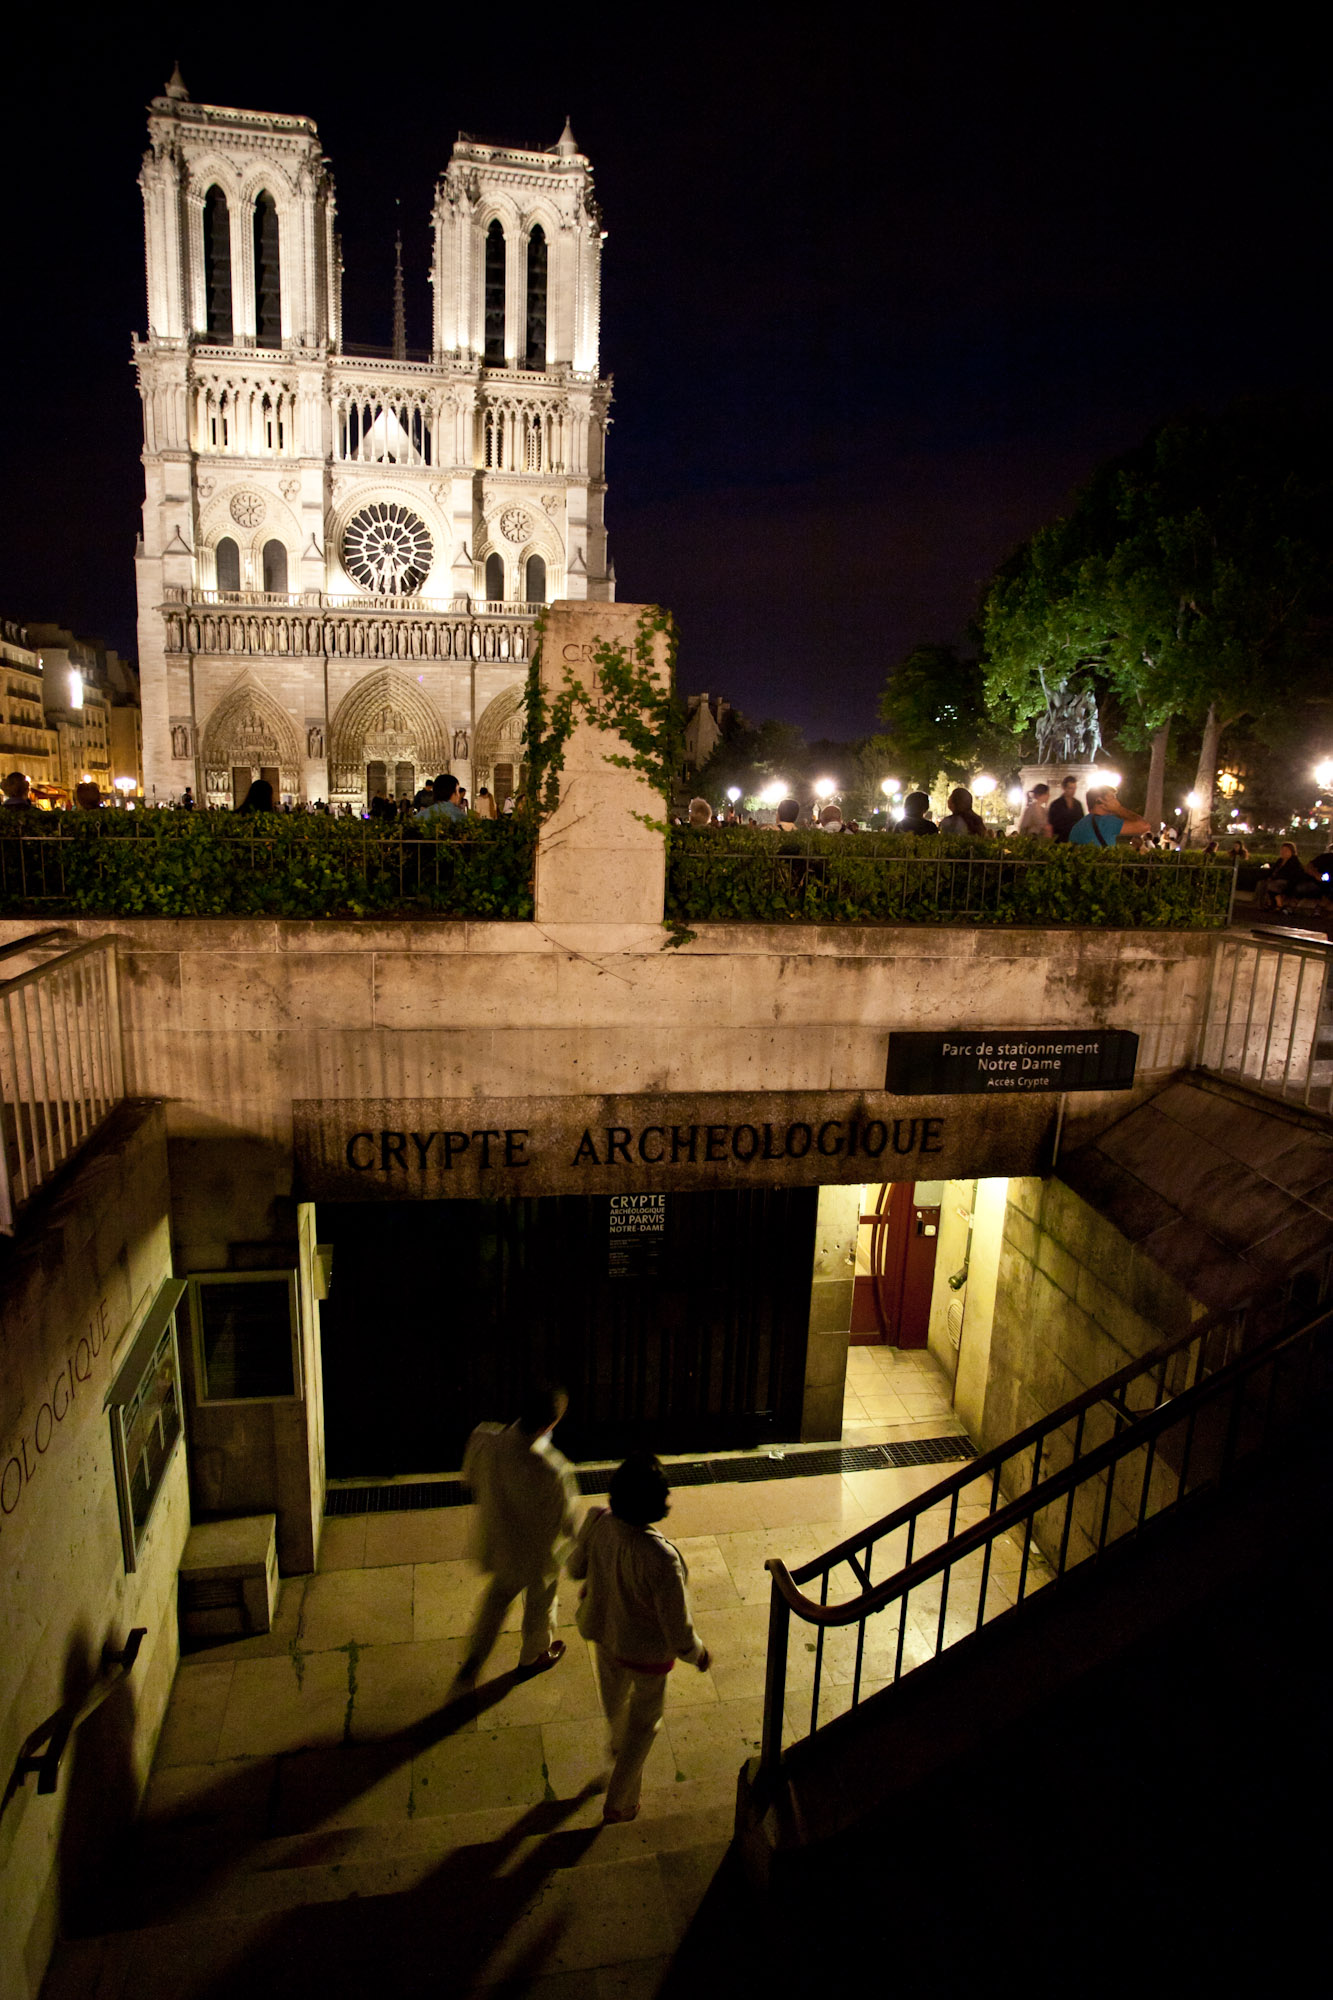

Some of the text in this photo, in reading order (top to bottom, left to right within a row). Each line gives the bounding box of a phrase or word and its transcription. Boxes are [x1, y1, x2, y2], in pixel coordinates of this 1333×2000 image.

[942, 1041, 1099, 1056] Parc de stationnement
[978, 1056, 1062, 1071] Notre Dame
[988, 1075, 1050, 1088] Accès Crypte
[346, 1117, 945, 1170] CRYPTE ARCHEOLOGIQUE
[610, 1194, 666, 1208] CRYPTE
[610, 1213, 665, 1225] DU PARVIS
[609, 1224, 665, 1233] NOTRE-DAME
